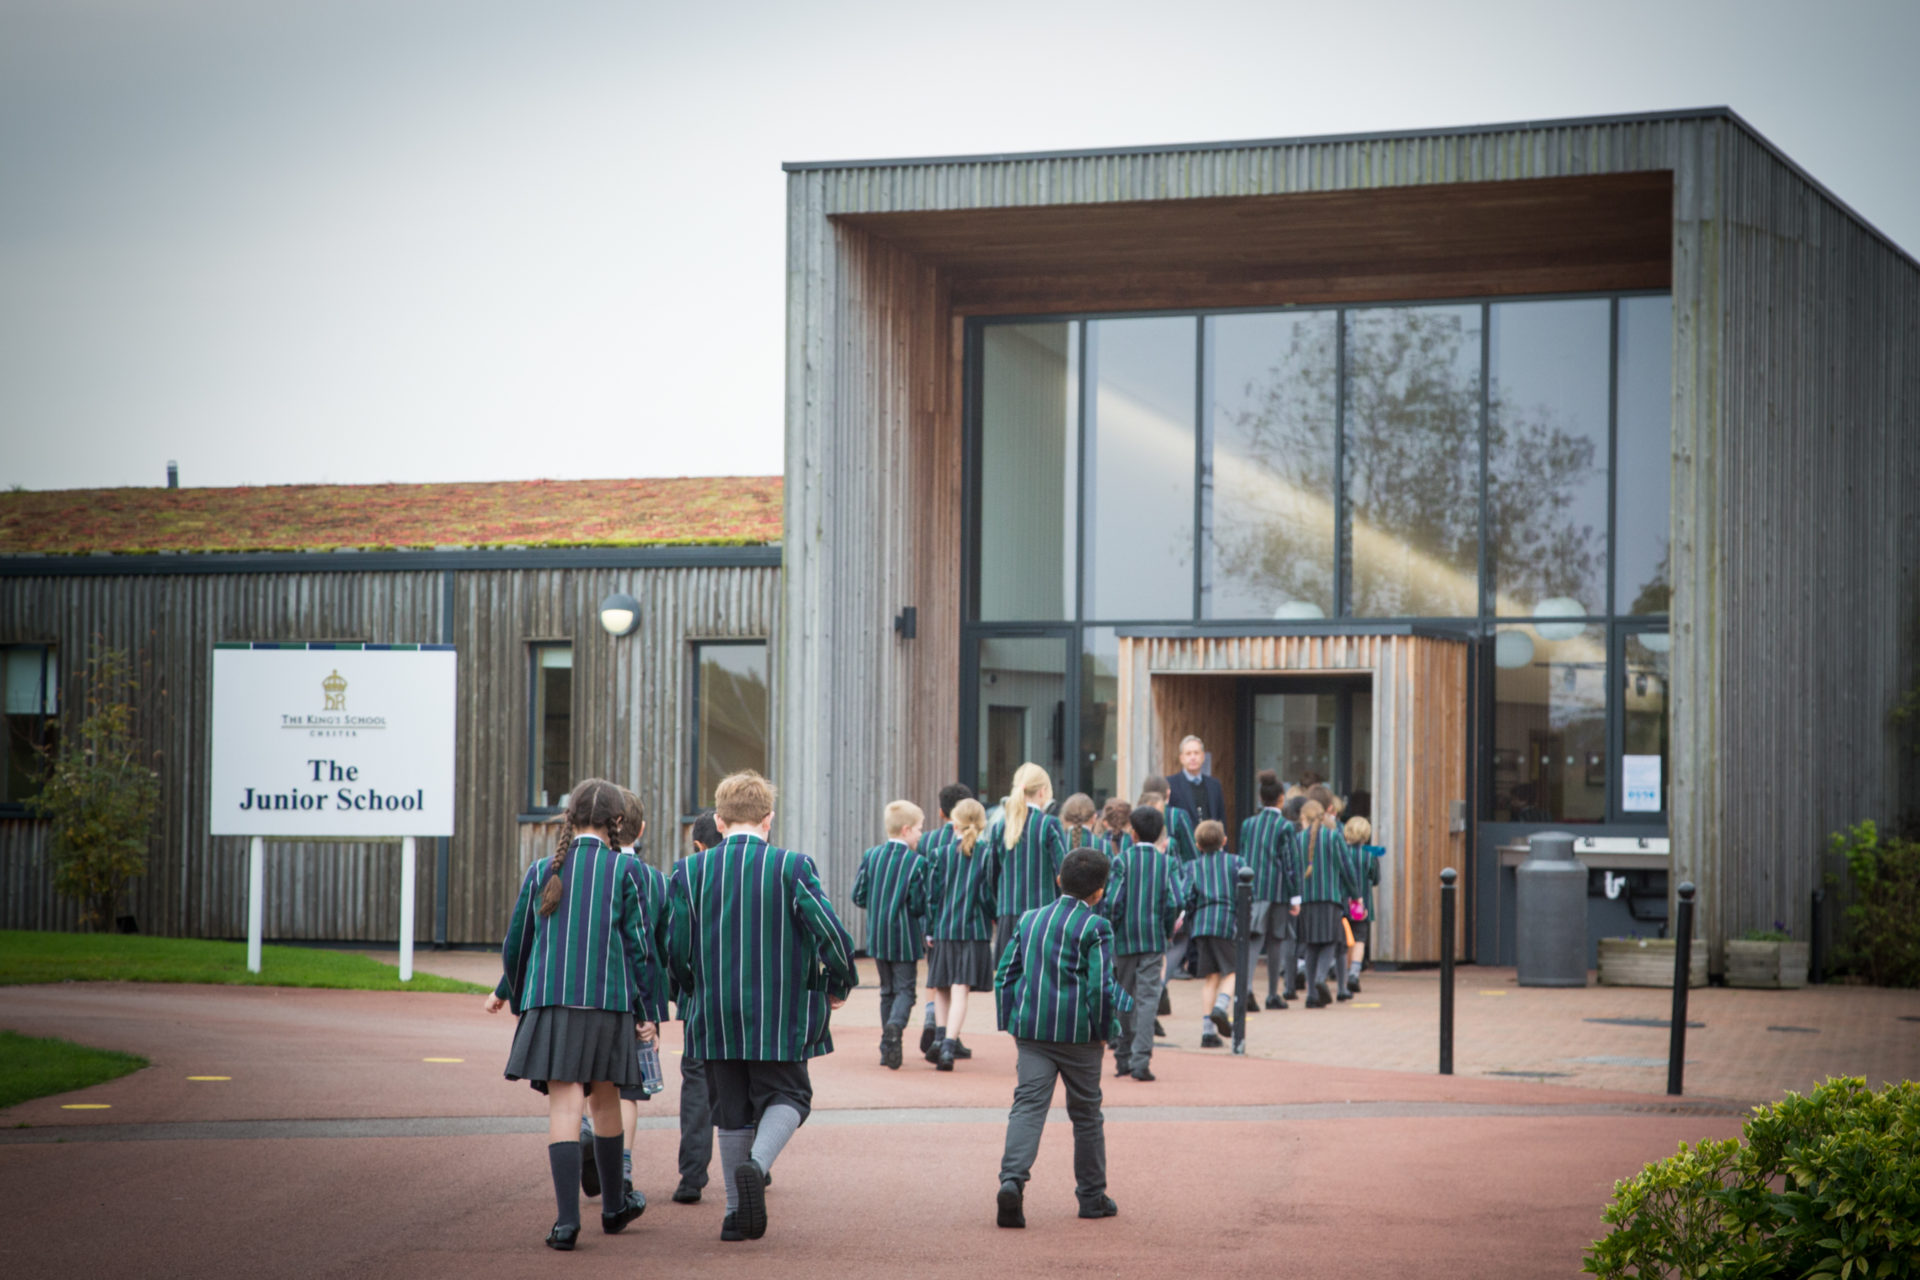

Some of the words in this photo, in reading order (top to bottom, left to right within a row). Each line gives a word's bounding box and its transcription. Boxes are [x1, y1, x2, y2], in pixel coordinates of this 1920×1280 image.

[282, 714, 302, 724] THE
[307, 715, 341, 725] KING'S
[345, 715, 386, 725] SCHOOL
[308, 760, 359, 782] The
[239, 788, 328, 811] Junior
[337, 788, 424, 811] School
